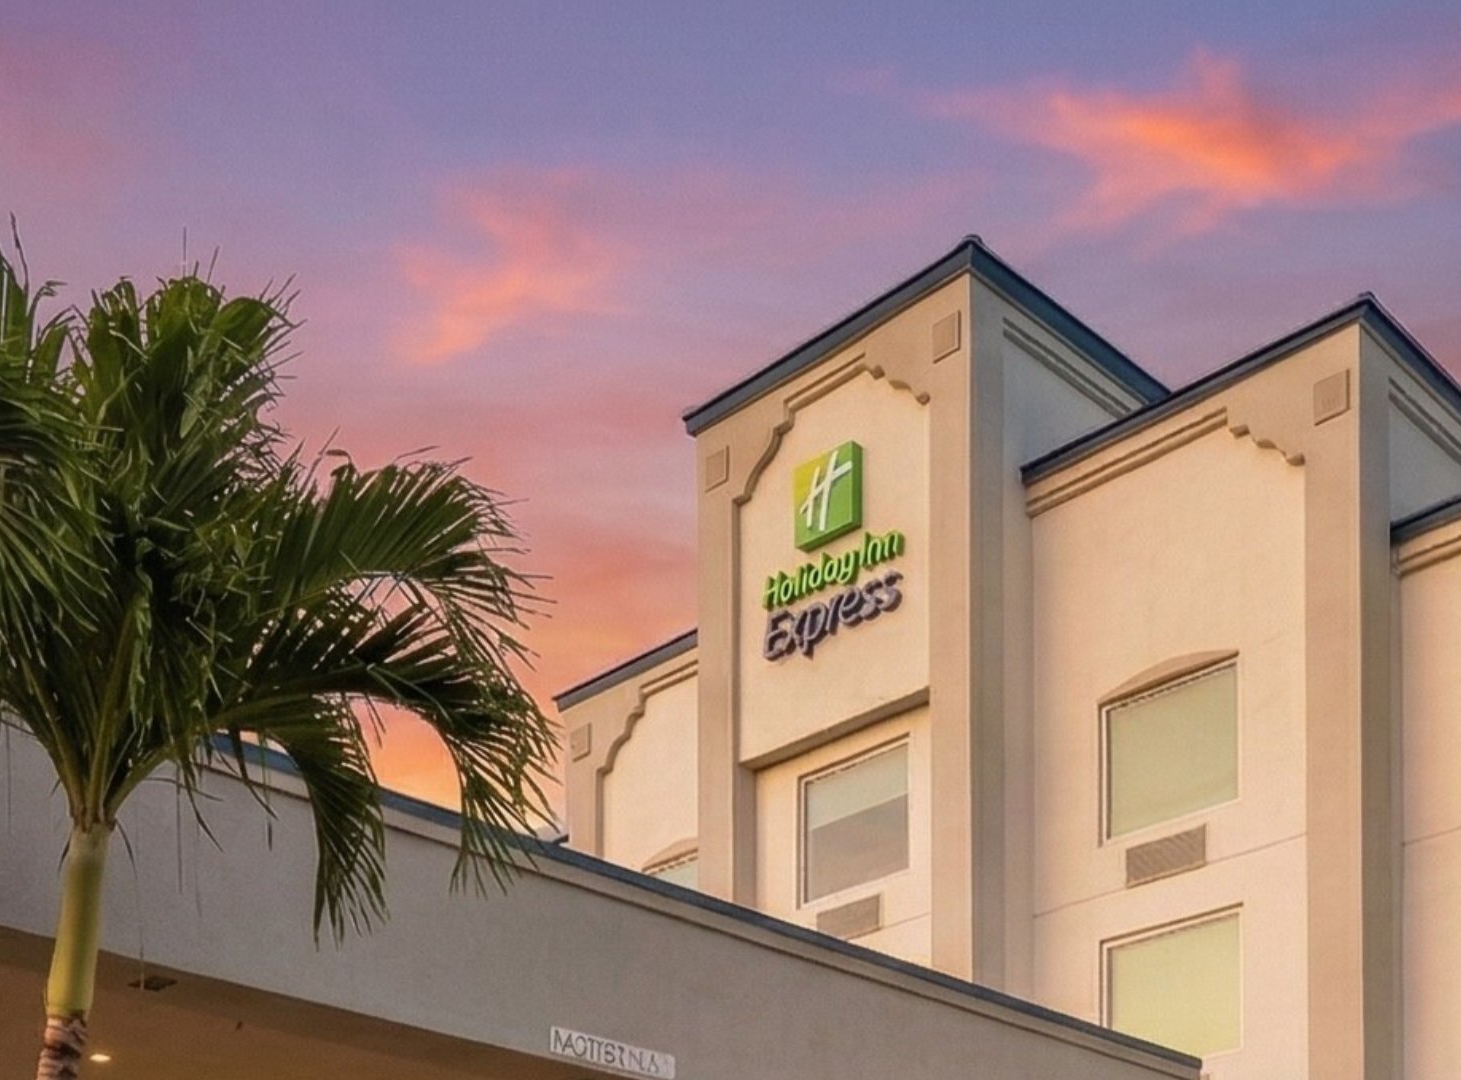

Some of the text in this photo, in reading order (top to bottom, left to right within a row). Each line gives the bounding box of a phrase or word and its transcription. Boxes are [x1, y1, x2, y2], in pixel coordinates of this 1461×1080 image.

[762, 530, 905, 608] Holiday Inn
[763, 569, 904, 661] Express
